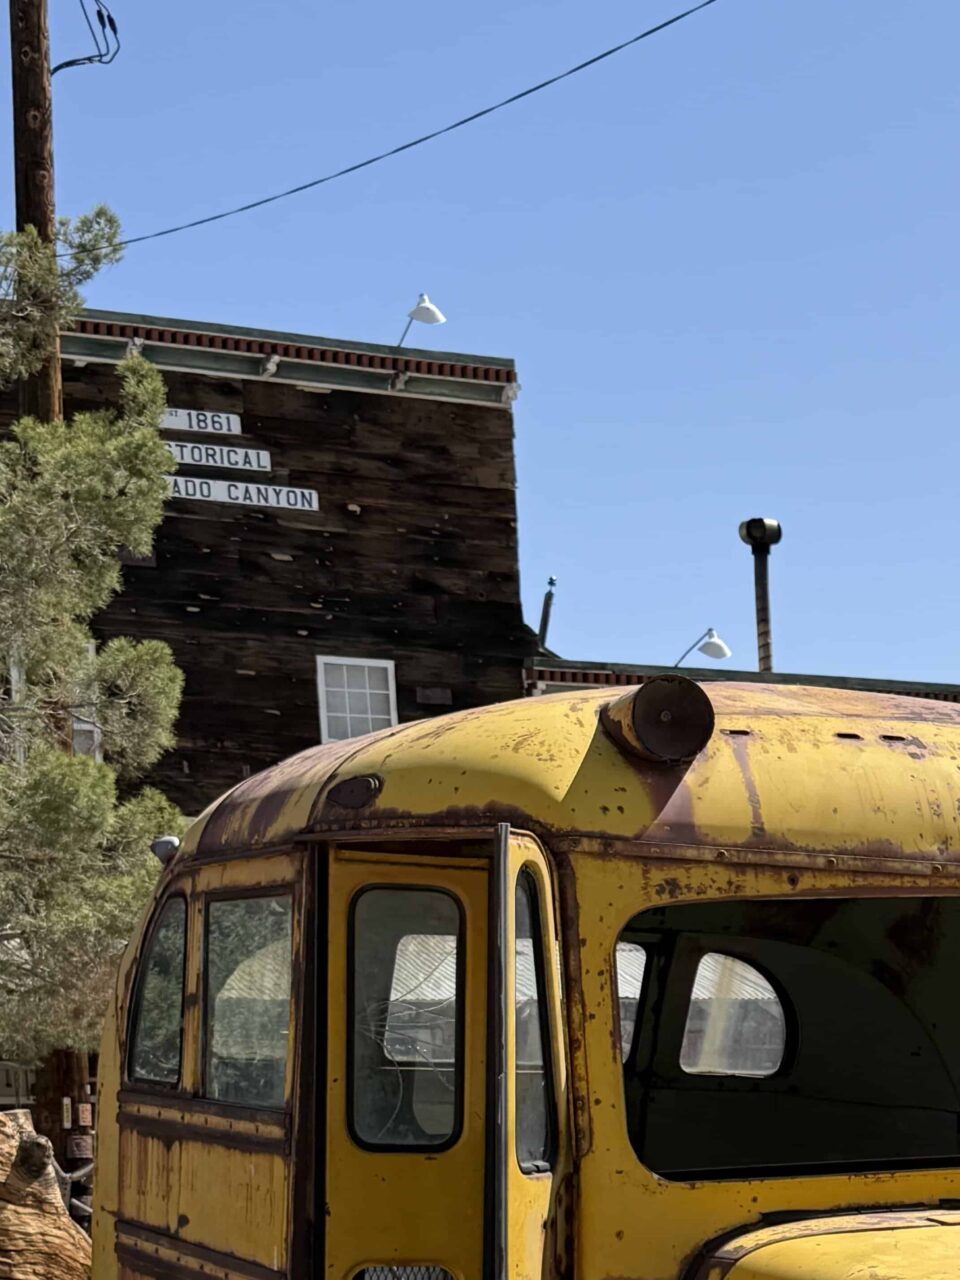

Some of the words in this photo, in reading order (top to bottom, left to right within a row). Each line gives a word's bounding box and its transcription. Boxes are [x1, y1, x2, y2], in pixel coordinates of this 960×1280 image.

[187, 411, 232, 432] 1861
[172, 478, 211, 498] ADO
[227, 483, 313, 508] CANYON
